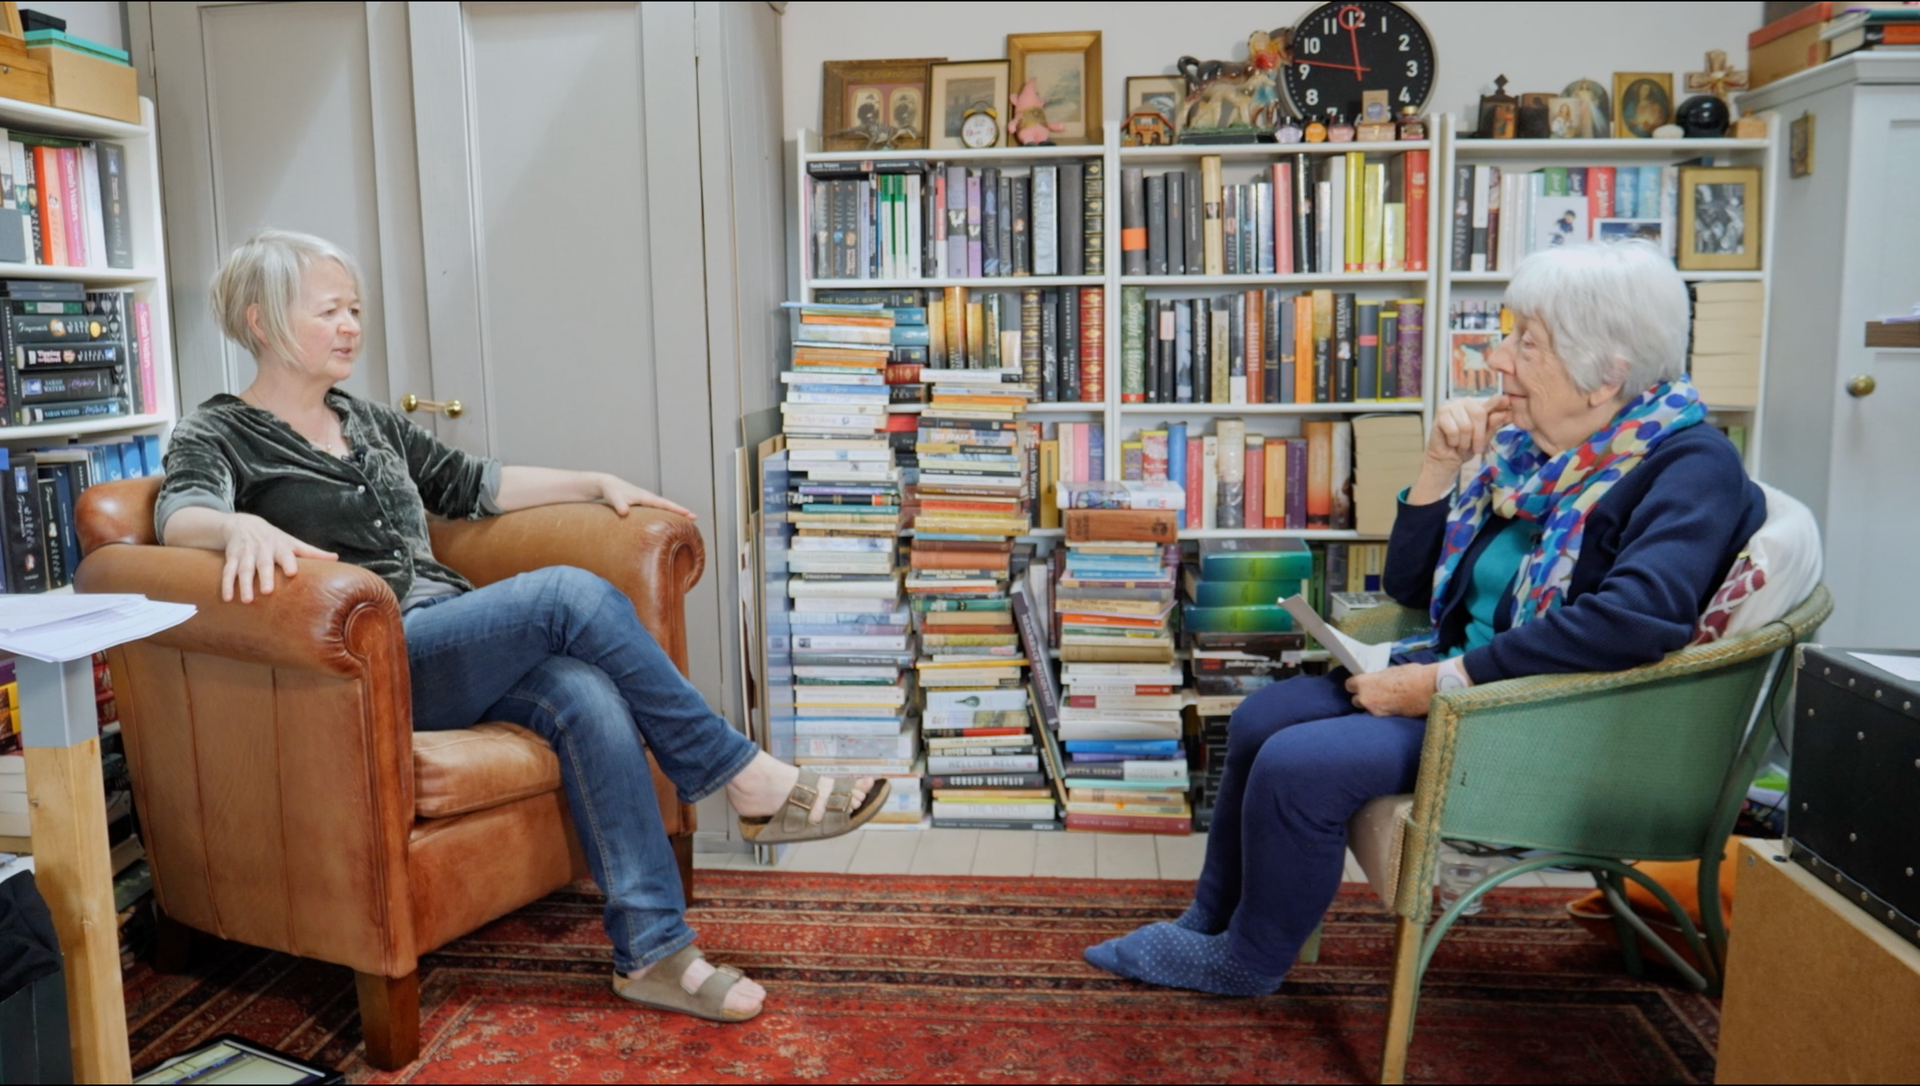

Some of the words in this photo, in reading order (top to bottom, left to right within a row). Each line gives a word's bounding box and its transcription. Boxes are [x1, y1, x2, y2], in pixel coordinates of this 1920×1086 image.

[1323, 18, 1338, 34] 11
[1348, 11, 1365, 27] 12
[1381, 16, 1387, 33] 1
[1304, 37, 1320, 54] 10
[1398, 35, 1410, 52] 2
[1298, 64, 1310, 80] 9
[1406, 61, 1418, 78] 3
[1306, 89, 1319, 105] 8
[1398, 86, 1411, 104] 4
[66, 158, 77, 188] Sarah
[68, 188, 79, 222] Waters
[140, 312, 148, 339] Sarah
[1127, 301, 1142, 336] Sarah
[1336, 298, 1346, 338] WATERS
[78, 350, 105, 362] WATERS
[143, 339, 152, 368] Waters
[1126, 350, 1142, 389] Waters
[44, 410, 60, 418] SARAH
[61, 408, 80, 416] WATERS
[1030, 449, 1038, 472] Sarah
[1030, 472, 1038, 500] Waters
[16, 495, 26, 538] Fingersmith
[1020, 613, 1038, 651] MEMORIES
[1031, 651, 1040, 661] OF
[1034, 661, 1049, 690] BRITAIN
[1042, 690, 1053, 707] PAST
[948, 760, 990, 768] HELLISH
[994, 759, 1018, 768] NELL
[950, 776, 984, 785] CURSED
[986, 776, 1024, 785] BRITAIN
[967, 804, 988, 812] THE
[992, 804, 1026, 812] WITCH
[1072, 818, 1099, 826] MARINA
